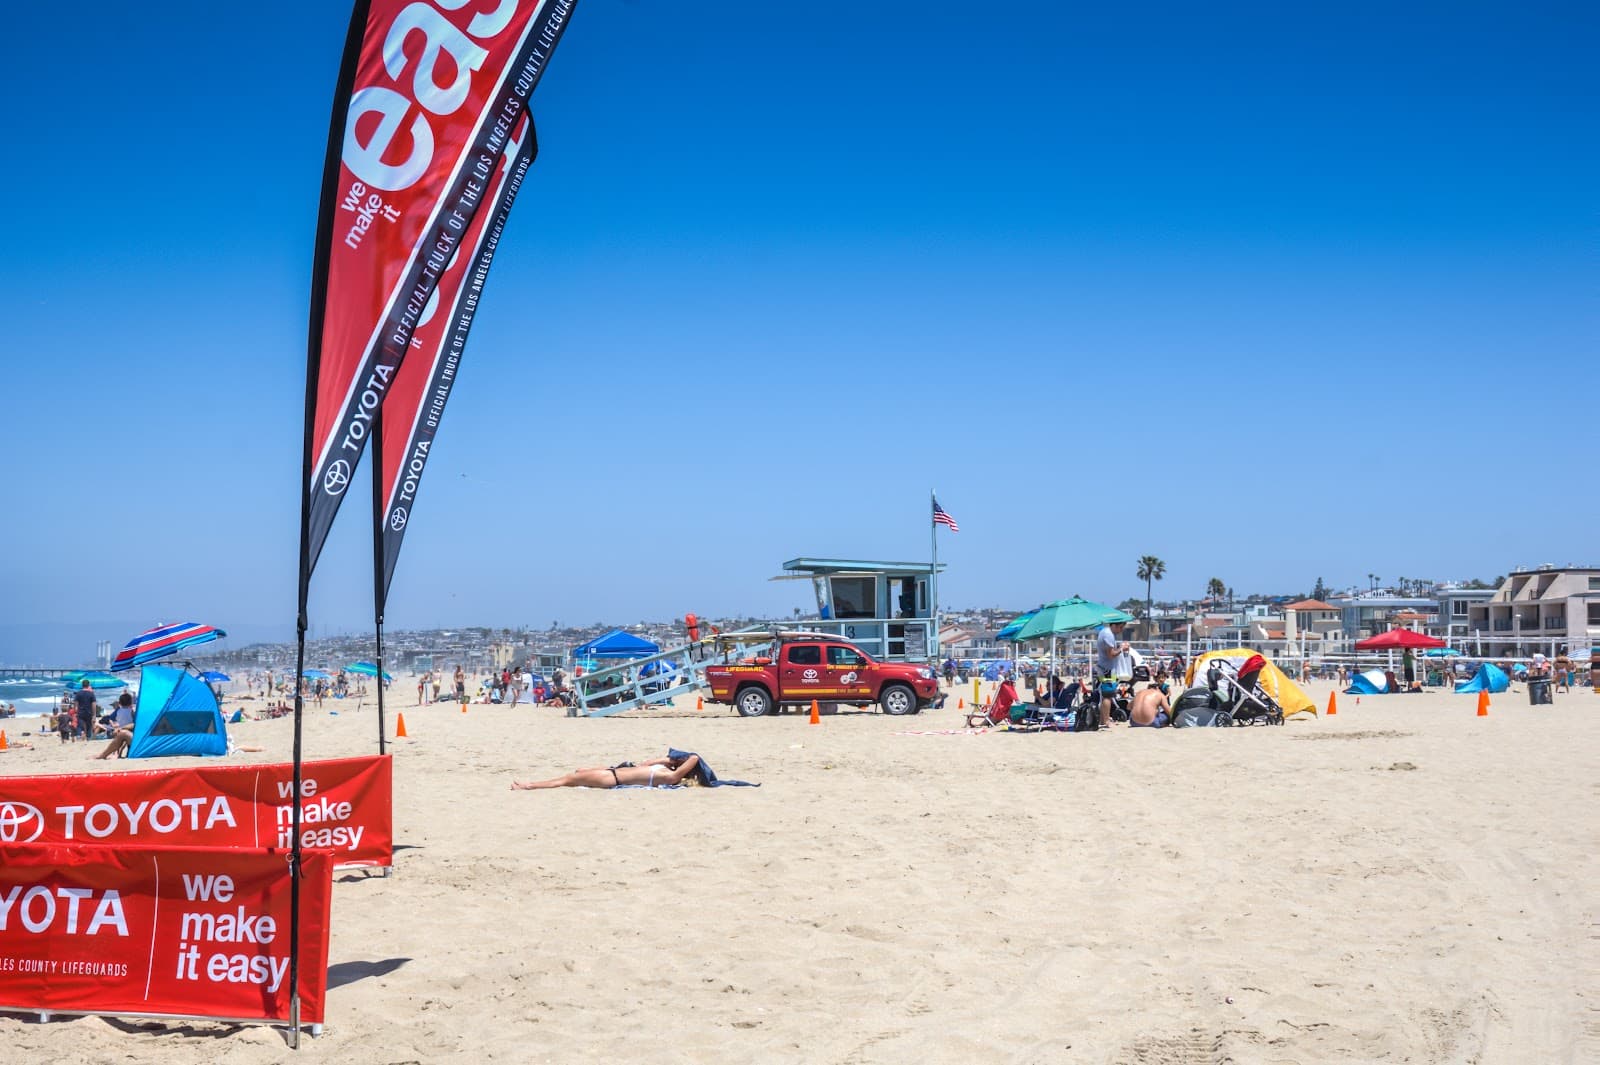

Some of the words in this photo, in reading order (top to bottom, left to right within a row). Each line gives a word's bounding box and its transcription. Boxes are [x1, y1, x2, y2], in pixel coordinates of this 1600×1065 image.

[341, 182, 366, 212] we
[502, 156, 530, 212] LIFEGUARDS
[342, 364, 395, 451] TOYOTA
[393, 283, 430, 345] OFFICIAL
[423, 232, 456, 279] TRUCK
[448, 210, 466, 230] OF
[460, 180, 481, 207] THE
[473, 154, 493, 180] LOS
[486, 97, 520, 155] ANGELES
[514, 48, 545, 97] COUNTY
[538, 0, 573, 49] LIFEGUA
[345, 194, 383, 249] make
[379, 204, 401, 223] it
[487, 212, 506, 250] COUNTY
[472, 251, 493, 291] ANGELES
[465, 294, 478, 311] LOS
[458, 313, 472, 331] THE
[410, 337, 423, 349] it
[453, 335, 465, 348] OF
[442, 350, 460, 380] TRUCK
[426, 385, 449, 427] OFFICIAL
[400, 440, 431, 501] TOYOTA
[276, 778, 318, 798] we
[55, 796, 238, 840] TOYOTA
[276, 796, 352, 825] make
[301, 825, 365, 851] easy
[182, 874, 235, 903] we
[181, 905, 277, 944] make
[18, 959, 58, 974] COUNTY
[62, 961, 128, 977] LIFEGUARDS
[176, 942, 201, 981] it
[207, 953, 290, 993] easy
